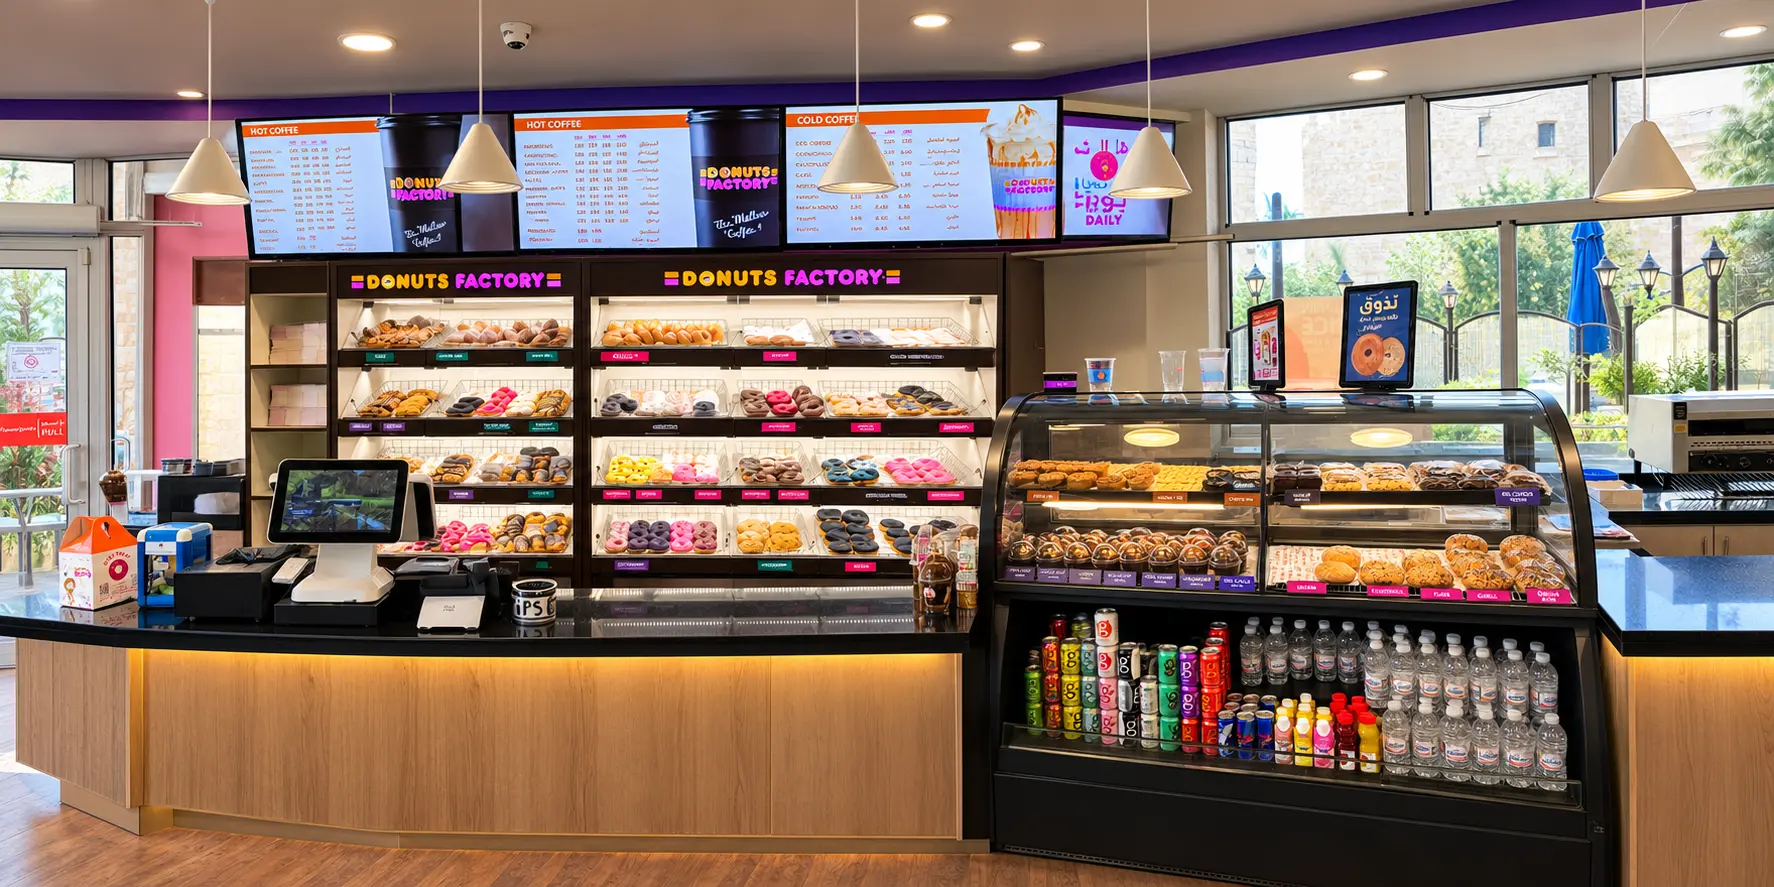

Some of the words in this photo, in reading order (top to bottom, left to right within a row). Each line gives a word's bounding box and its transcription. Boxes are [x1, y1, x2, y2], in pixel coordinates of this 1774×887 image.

[526, 121, 546, 129] HOT
[547, 119, 582, 128] COFFEE
[797, 116, 823, 124] COLD
[250, 127, 268, 135] HOT
[707, 177, 770, 190] FACTORY
[1085, 214, 1123, 226] DAILY
[366, 273, 449, 290] DONUTS
[455, 272, 544, 289] FACTORY
[682, 269, 777, 287] DONUTS
[784, 269, 883, 286] FACTORY
